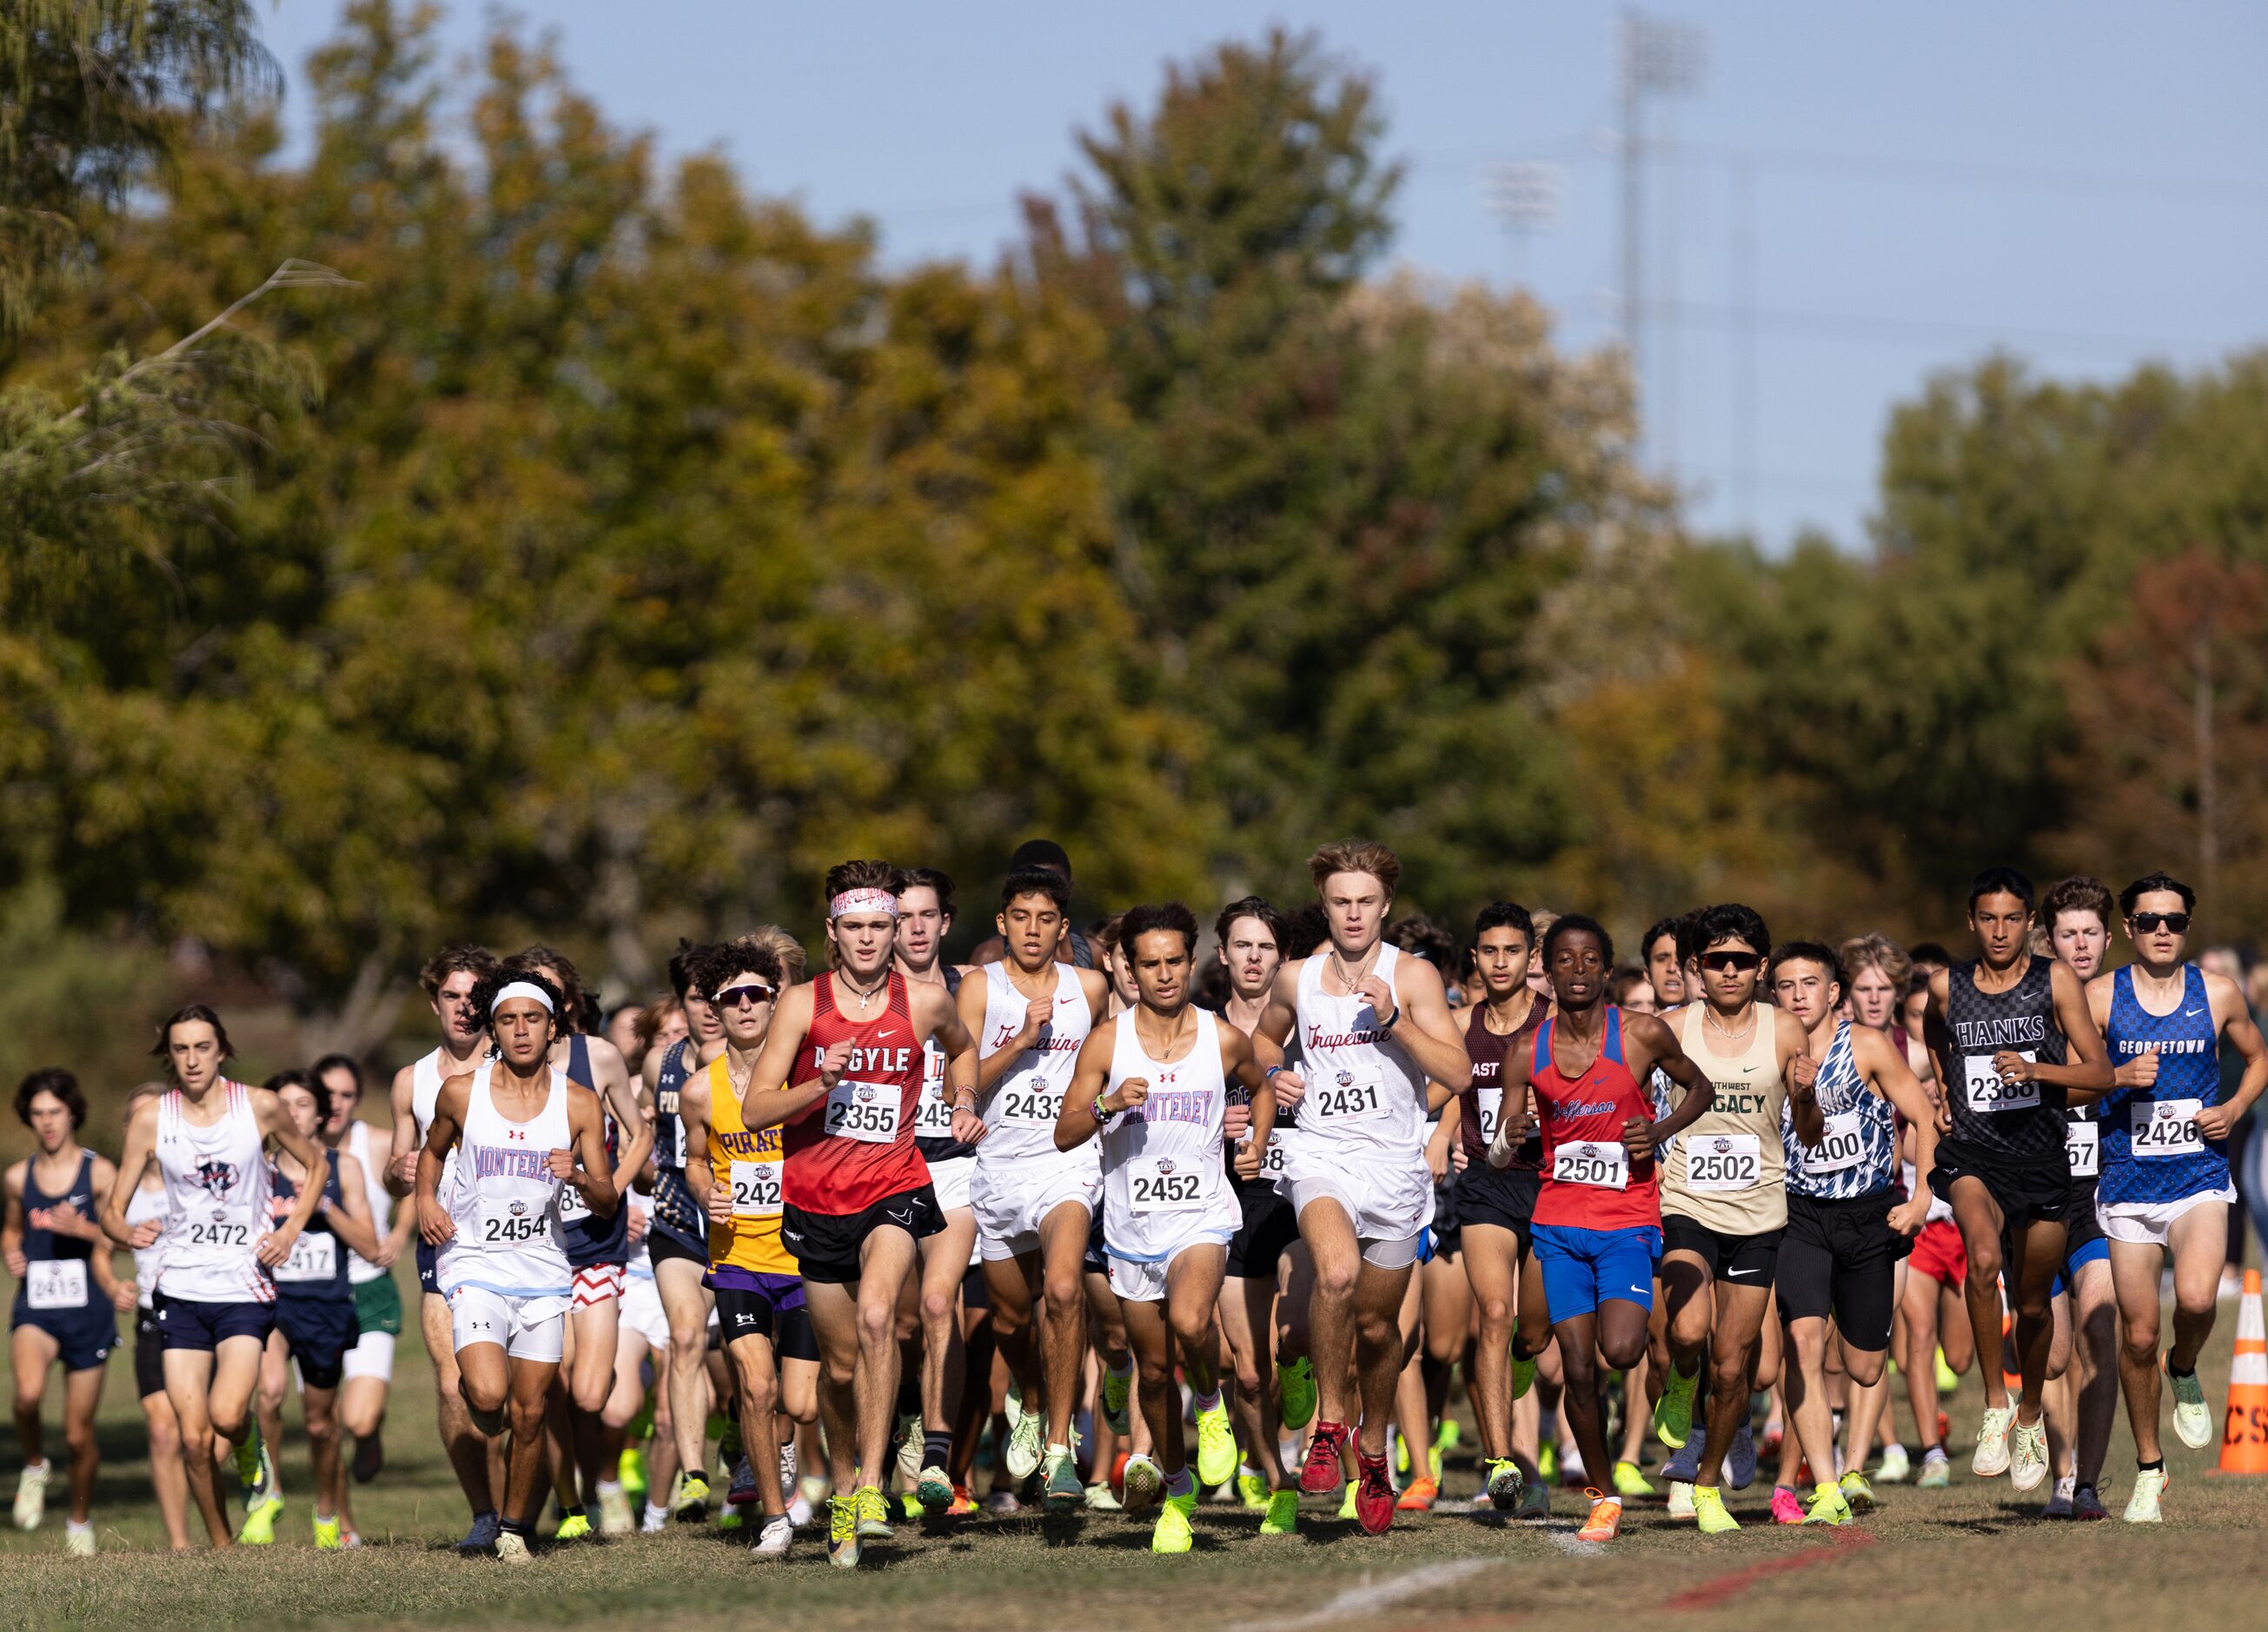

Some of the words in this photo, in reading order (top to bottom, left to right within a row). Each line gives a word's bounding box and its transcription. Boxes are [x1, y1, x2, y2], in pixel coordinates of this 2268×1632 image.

[1305, 1025, 1392, 1053] Grapevine
[1956, 1015, 2045, 1047] HANKS
[813, 1045, 912, 1071] AGYLE
[1472, 1063, 1500, 1076] AST
[1712, 1082, 1751, 1091] UTHWEST
[1318, 1085, 1378, 1117] 2431
[1552, 1099, 1616, 1122] Jefferson
[1707, 1094, 1766, 1114] GACY
[830, 1102, 894, 1132] 2355
[915, 1103, 952, 1127] 245
[720, 1129, 783, 1154] PIRAT
[2135, 1119, 2198, 1145] 2426
[2067, 1143, 2094, 1166] 57
[1557, 1158, 1619, 1183] 2501
[1691, 1156, 1754, 1180] 2502
[735, 1182, 782, 1205] 242
[1133, 1176, 1200, 1203] 2452
[191, 1224, 249, 1246] 2472
[485, 1215, 547, 1242] 2454
[291, 1250, 328, 1270] 417
